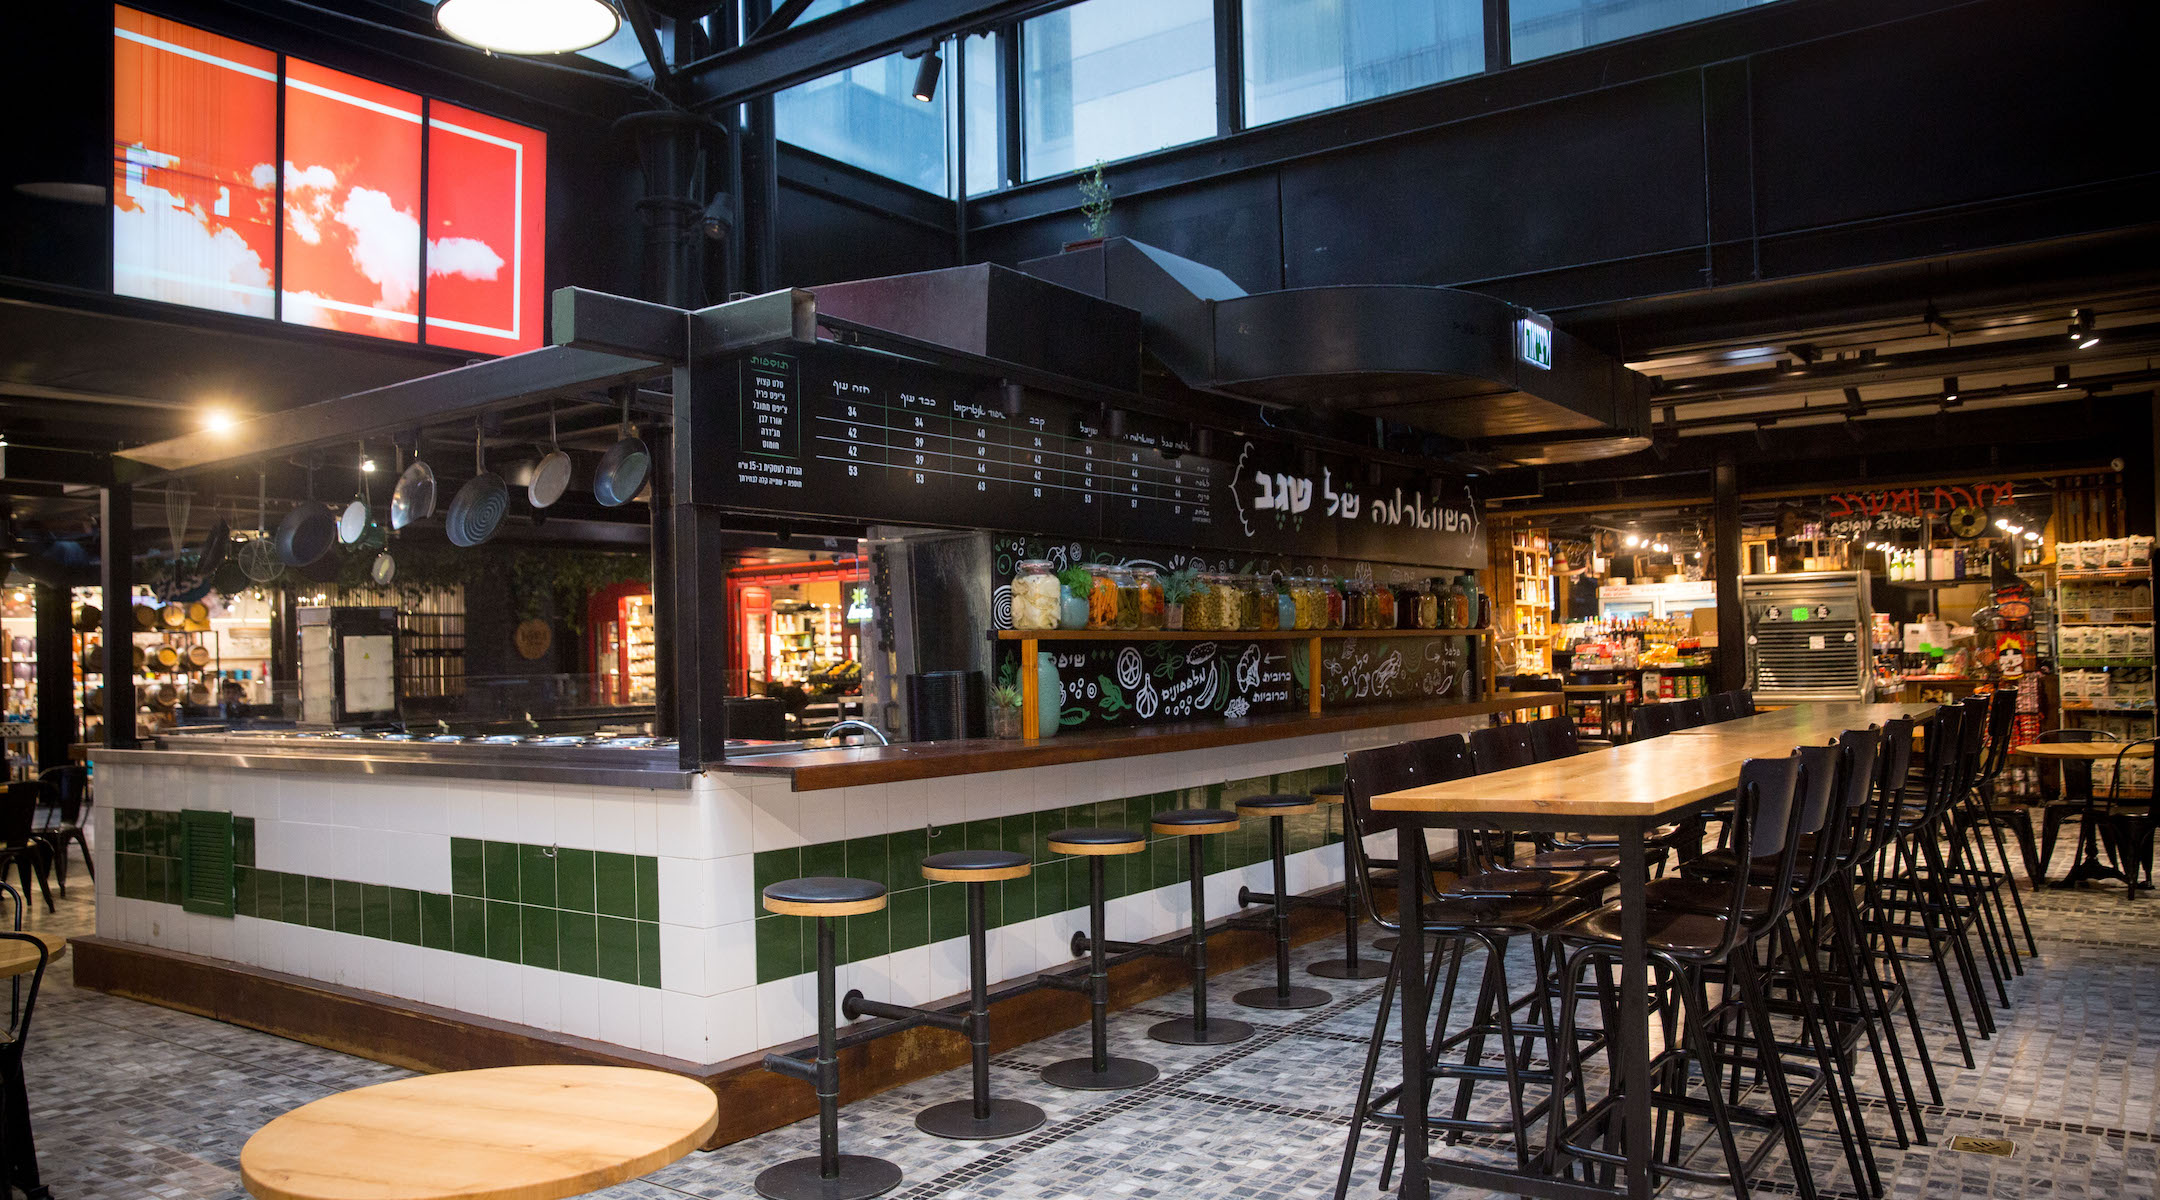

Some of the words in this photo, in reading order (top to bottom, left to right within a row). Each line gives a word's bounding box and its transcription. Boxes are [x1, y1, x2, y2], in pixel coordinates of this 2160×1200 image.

[750, 356, 789, 369] תוספות
[756, 377, 771, 387] קצוץ
[772, 379, 784, 388] סלט
[833, 380, 848, 395] עוף
[852, 384, 870, 394] חזה
[755, 389, 768, 398] פריך
[900, 393, 915, 408] עוף
[753, 400, 770, 411] מתובל
[918, 396, 936, 406] כבד
[953, 400, 986, 418] אנטריקוט
[759, 415, 768, 423] לבן
[770, 417, 783, 425] אורז
[1029, 417, 1045, 431] קבב
[848, 406, 857, 417] 34
[915, 417, 924, 427] 34
[978, 429, 985, 438] 40
[1034, 437, 1041, 447] 34
[762, 440, 779, 450] חומוס
[848, 427, 857, 438] 42
[915, 437, 924, 447] 39
[978, 446, 985, 456] 49
[1034, 455, 1041, 464] 42
[848, 446, 857, 457] 42
[915, 455, 924, 465] 39
[978, 463, 985, 473] 46
[1034, 471, 1041, 480] 42
[786, 466, 802, 475] הגדלה
[848, 465, 857, 477] 53
[915, 473, 924, 484] 53
[978, 481, 985, 491] 63
[1034, 488, 1041, 497] 53
[1255, 471, 1313, 514] שגב
[1324, 466, 1359, 519] של
[1935, 482, 2016, 511] מזרח
[1830, 489, 1922, 517] ומערב
[1372, 487, 1471, 534] השווארמה
[1830, 519, 1872, 533] ASIAN
[1876, 516, 1922, 530] STORE
[1262, 672, 1291, 682] כרובית
[1161, 667, 1206, 702] מלפפונים
[1252, 690, 1289, 703] וכרוביות
